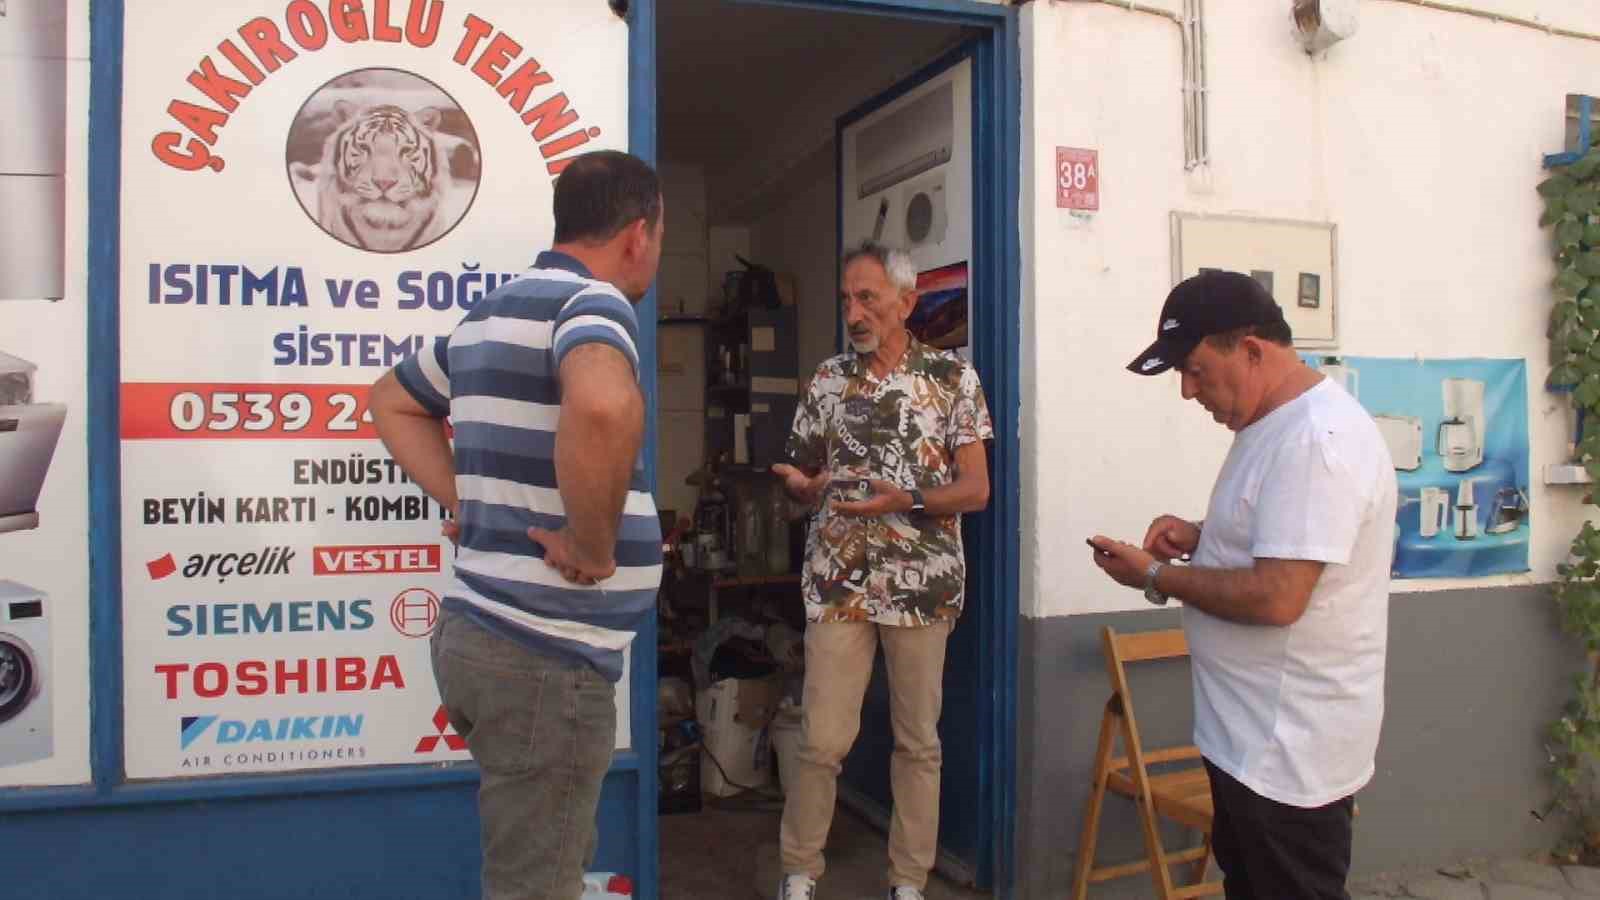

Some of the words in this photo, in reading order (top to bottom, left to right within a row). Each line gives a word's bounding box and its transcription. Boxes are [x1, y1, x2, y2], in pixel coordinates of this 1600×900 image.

[452, 13, 601, 176] TEKNİ
[148, 263, 309, 308] ISITMA
[325, 279, 380, 309] ve
[397, 262, 513, 311] SOĞ
[169, 391, 312, 432] 0539
[327, 392, 373, 432] 2
[143, 491, 225, 525] BEYİN
[236, 496, 316, 523] KARTI
[182, 547, 296, 583] arçelik
[319, 549, 438, 571] VESTEL
[166, 599, 374, 637] SIEMENS
[155, 654, 406, 700] TOSHIBA
[216, 713, 364, 744] DAIKIN
[182, 756, 212, 767] AIR
[223, 747, 367, 766] CONDITIONERS
